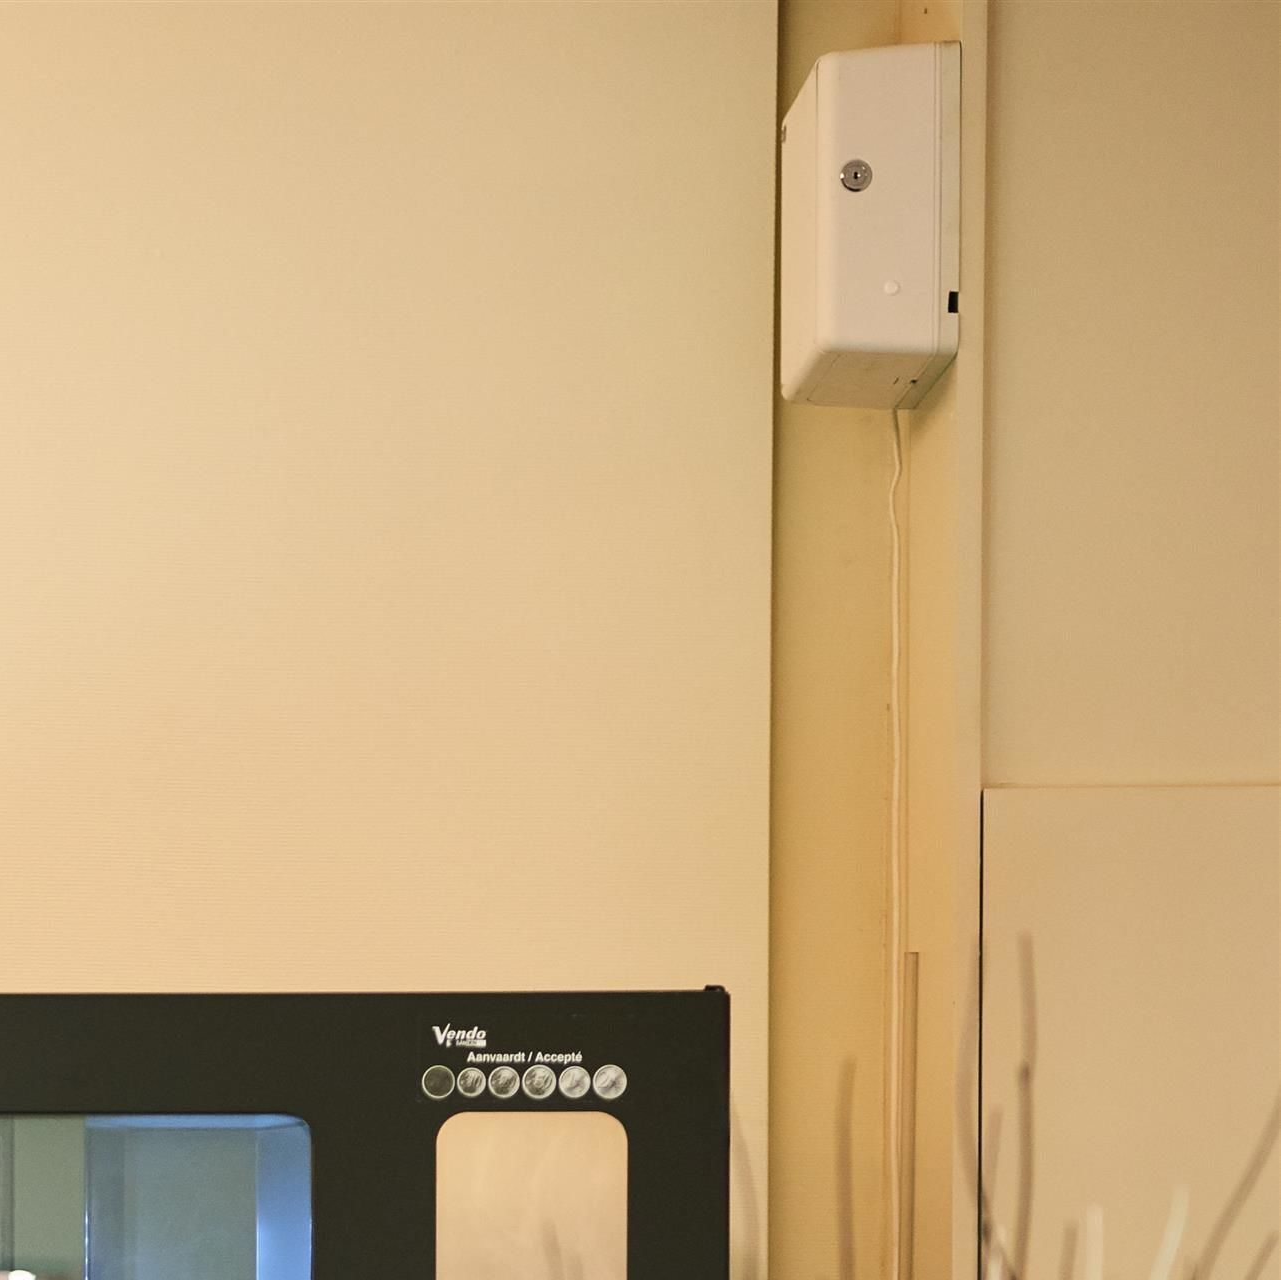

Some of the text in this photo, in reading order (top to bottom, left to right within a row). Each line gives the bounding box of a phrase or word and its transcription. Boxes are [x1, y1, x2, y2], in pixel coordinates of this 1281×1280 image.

[432, 1022, 487, 1045] Vendo
[466, 1050, 583, 1065] Aanvaardt / Accepté
